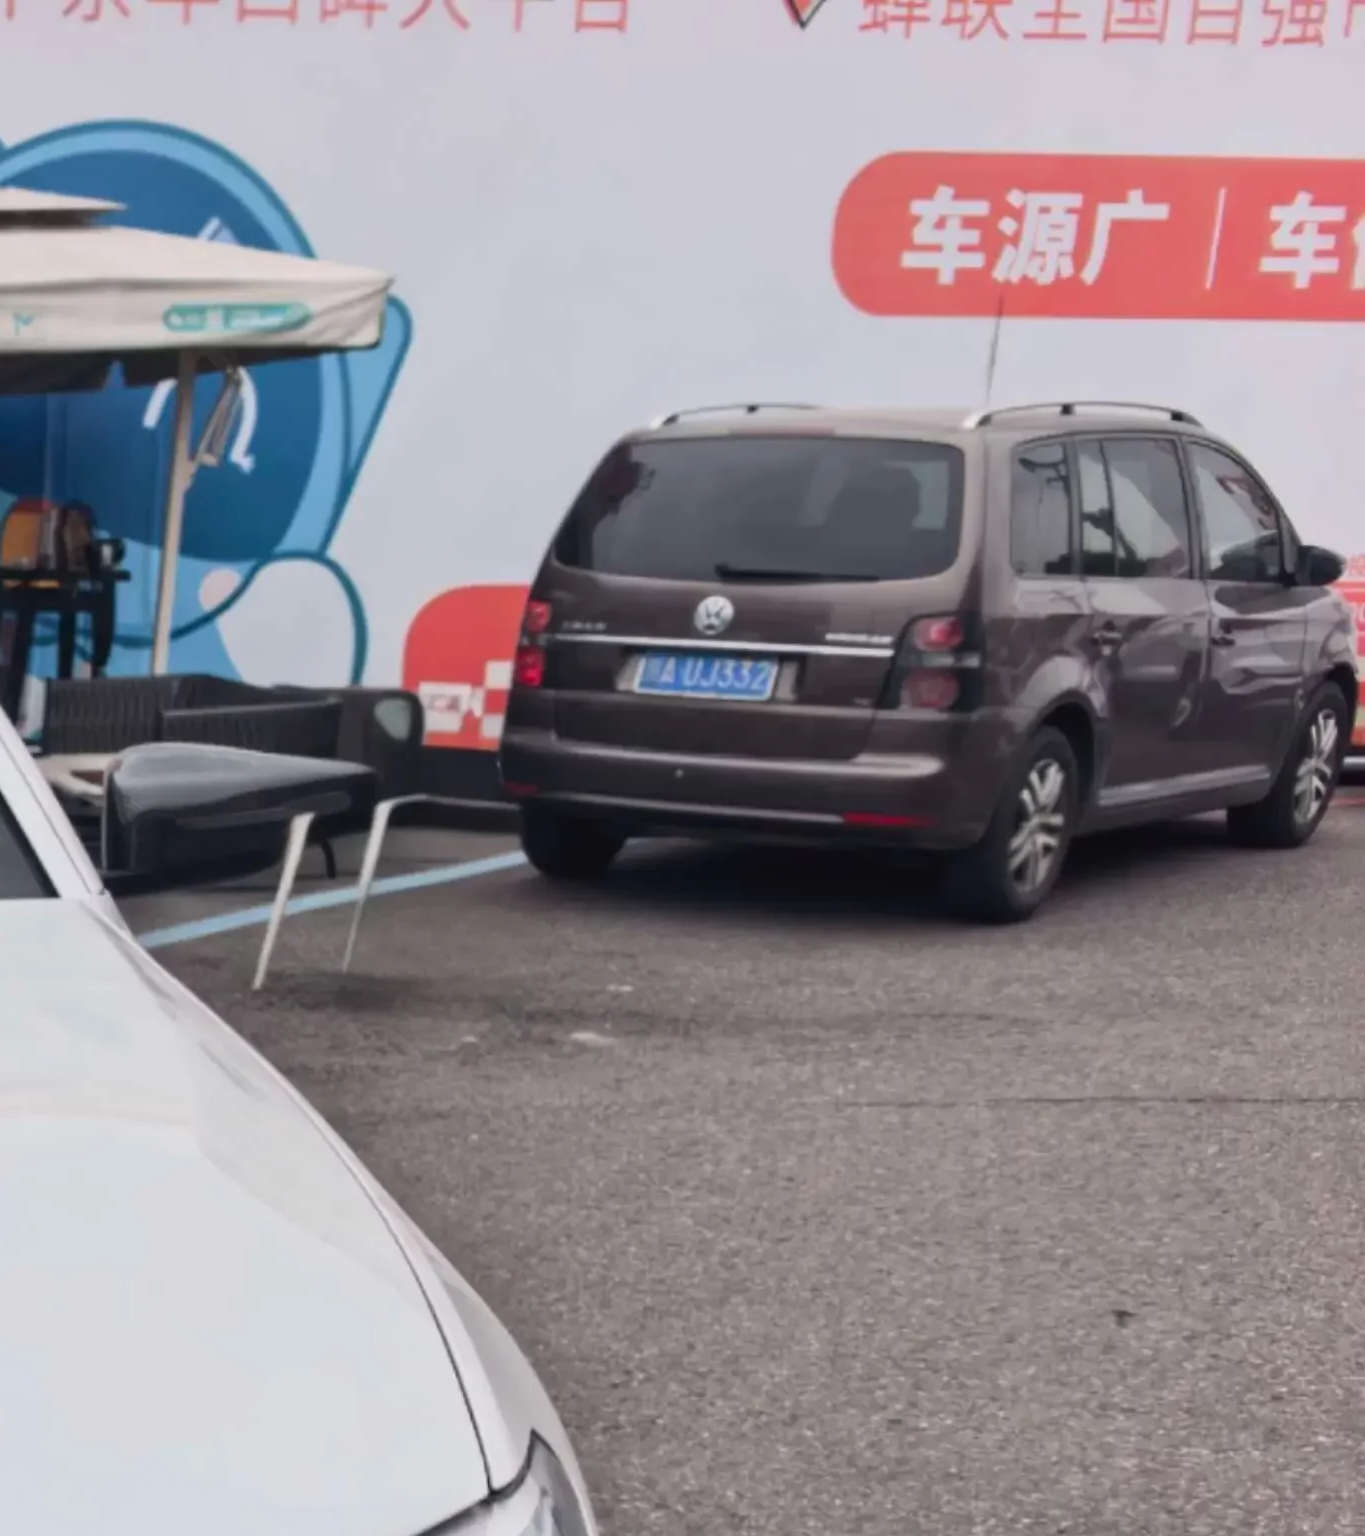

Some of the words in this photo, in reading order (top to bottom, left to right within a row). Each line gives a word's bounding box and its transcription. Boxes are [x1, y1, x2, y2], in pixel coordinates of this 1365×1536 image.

[899, 184, 1170, 286] 车源广
[1258, 190, 1365, 290] 车
